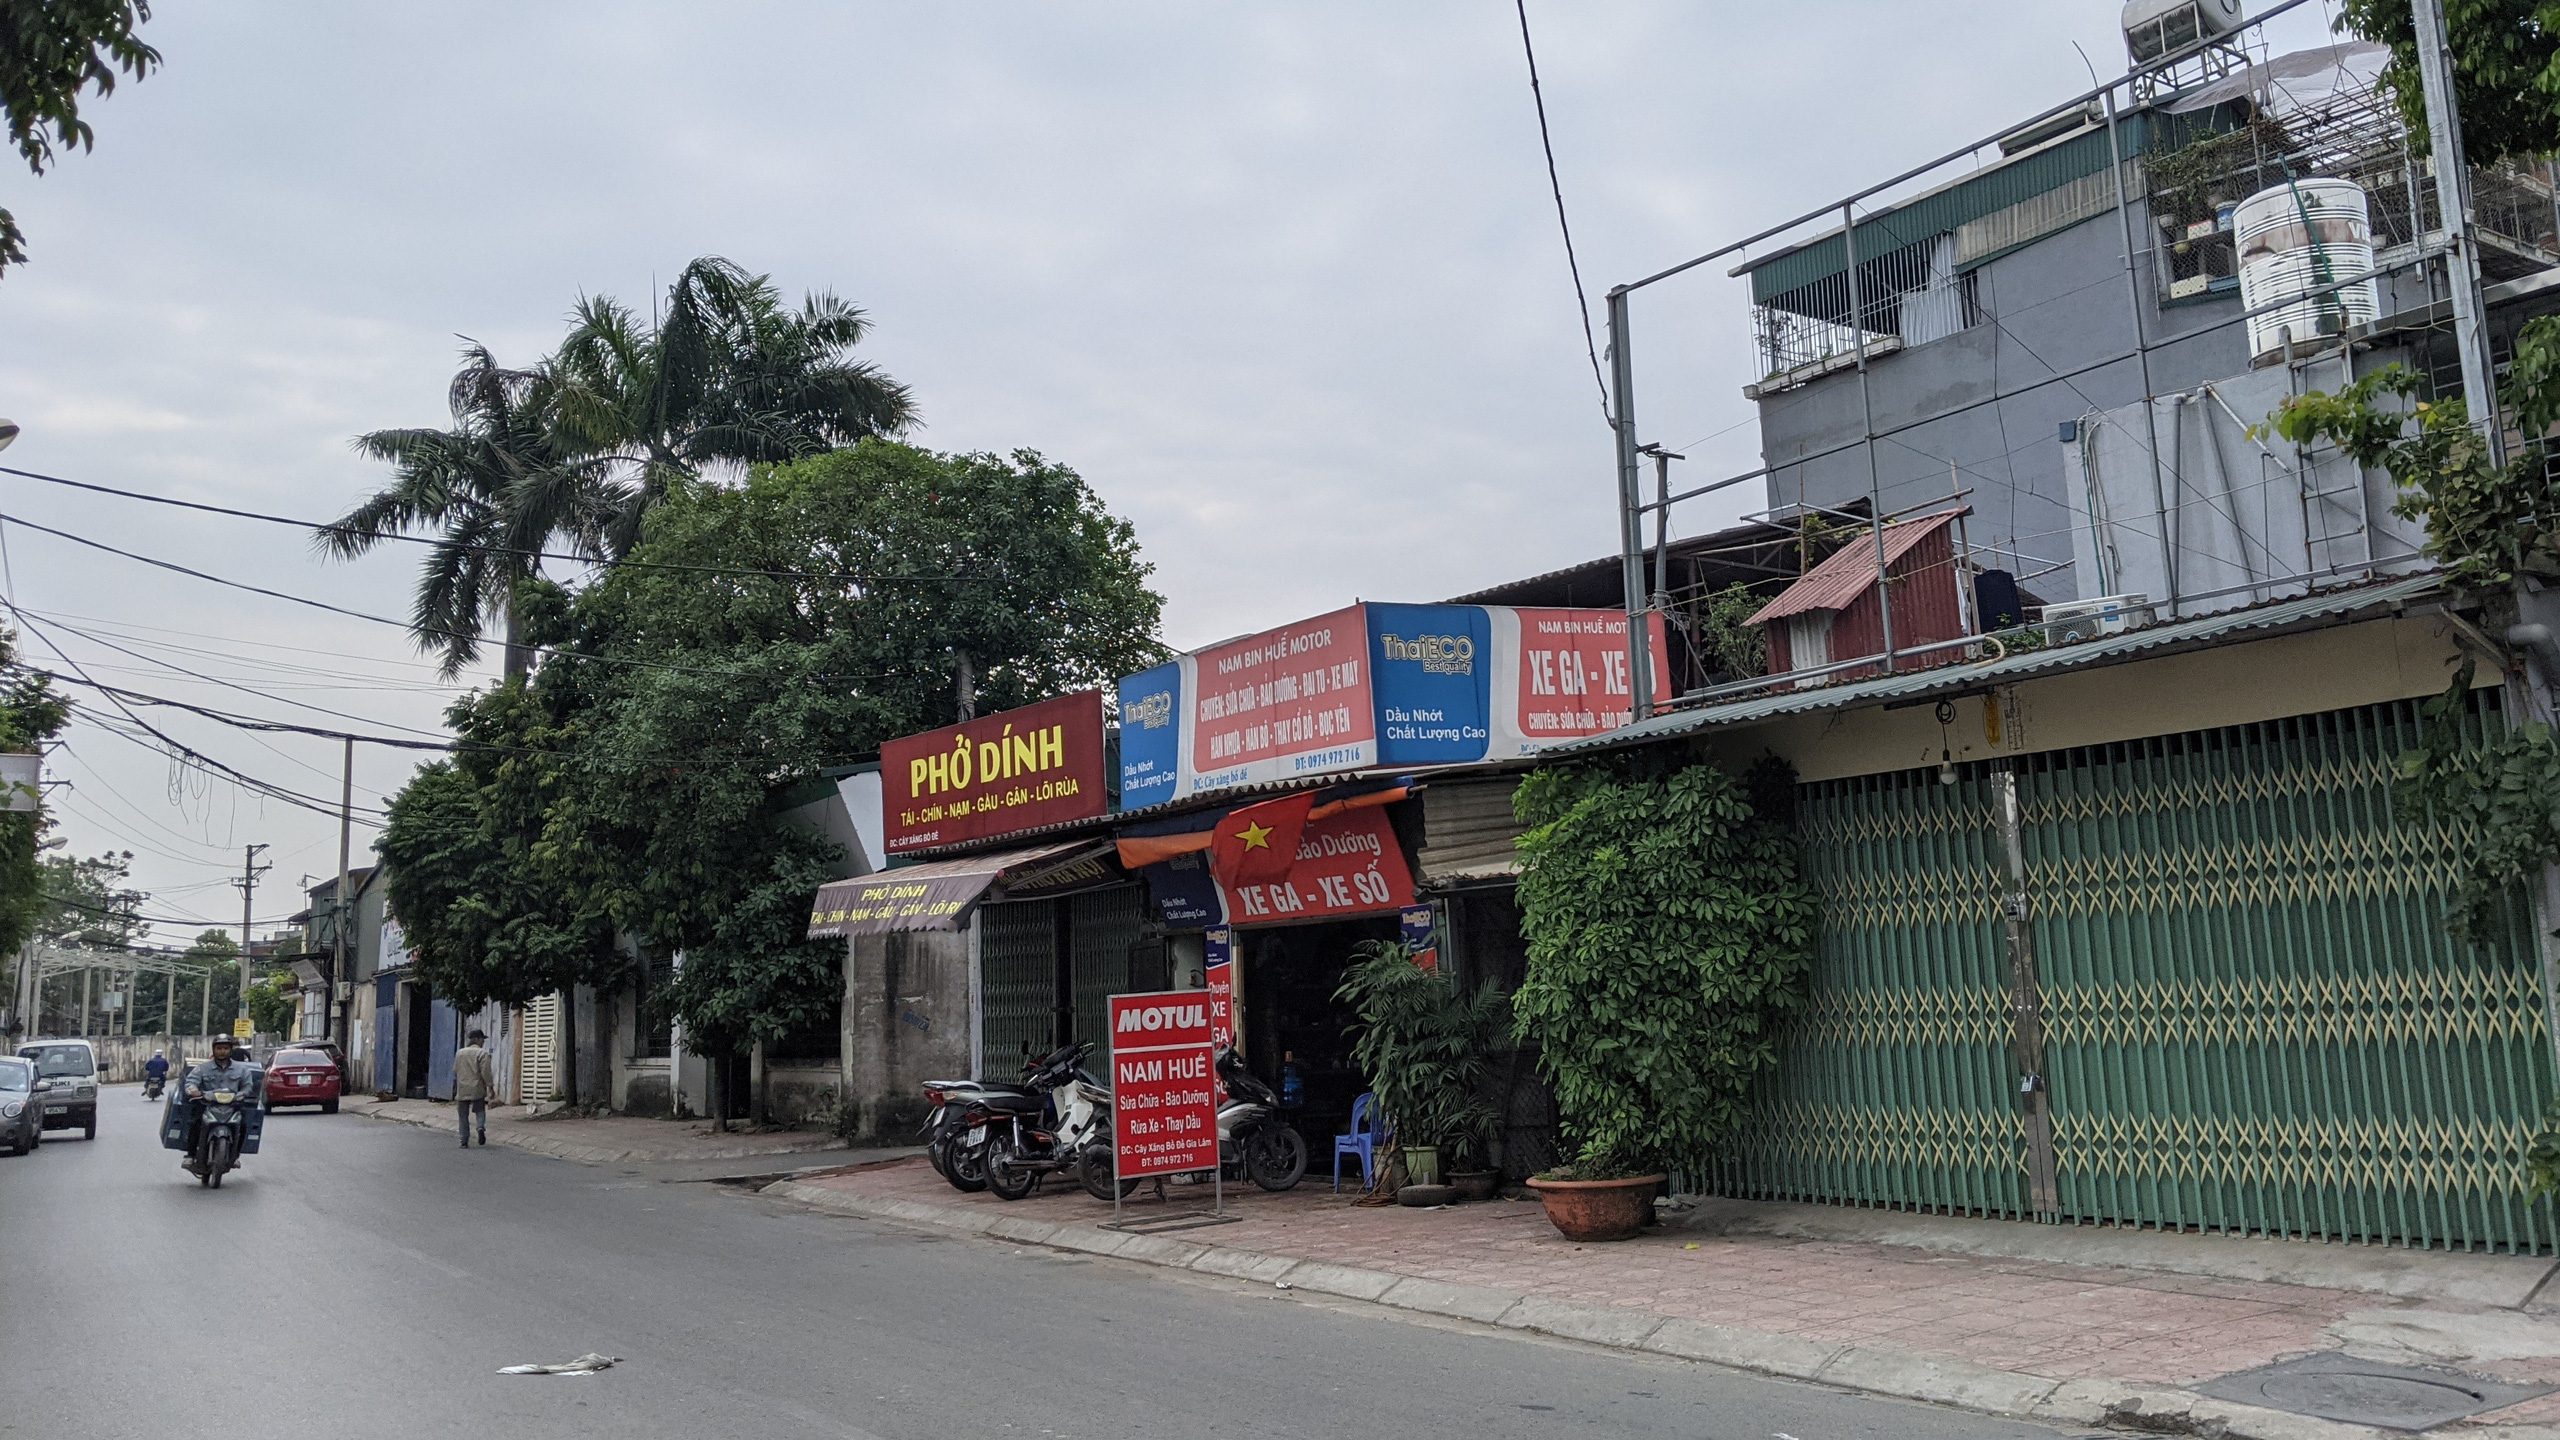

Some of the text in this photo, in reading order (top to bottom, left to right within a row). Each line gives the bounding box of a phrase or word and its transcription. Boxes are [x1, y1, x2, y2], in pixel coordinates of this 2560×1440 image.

[1538, 616, 1627, 634] NAM BIN HUẾ MOT
[1218, 628, 1332, 676] NAM BIN HUẾ MOTOR
[1381, 634, 1474, 660] ThaiECO
[1424, 660, 1472, 676] Best quality
[1528, 650, 1556, 695] XE
[1558, 650, 1588, 696] GA
[1601, 650, 1628, 695] XE
[1260, 672, 1273, 708] BẢO
[1302, 672, 1316, 702] ĐẠI
[1330, 664, 1342, 692] XE
[1342, 656, 1359, 688] MÁY
[1274, 718, 1291, 746] THAY
[1302, 710, 1313, 740] BÔ
[1318, 711, 1334, 742] BỌC
[1334, 703, 1351, 734] YÊN
[1385, 706, 1444, 722] Dầu Nhớt
[1560, 706, 1576, 730] SỬA
[1576, 708, 1596, 730] CHỮA
[1601, 706, 1616, 728] BẢO
[1386, 724, 1486, 742] Chất Lượng Cao
[910, 723, 1063, 798] PHỞ DÍNH
[1124, 760, 1154, 777] Dầu Nhớt
[1295, 747, 1360, 771] ĐT: 0974 972 716
[1124, 770, 1176, 791] Chất Lượng Cao
[900, 808, 915, 827] TÁI
[921, 802, 942, 824] CHÍN
[949, 800, 970, 820] NẠM
[1006, 786, 1028, 807] GÂN
[1036, 780, 1054, 801] LÕI
[1056, 776, 1079, 798] RÙA
[1321, 830, 1382, 856] Dưỡng
[861, 882, 928, 902] PHỞ DÍNH
[1237, 886, 1270, 916] XE
[1270, 881, 1304, 914] GA
[1316, 875, 1354, 908] XE
[1353, 858, 1390, 904] SỐ
[810, 908, 824, 924] TÁI
[826, 906, 846, 924] CHÍN
[850, 908, 871, 924] NẠM
[928, 900, 948, 916] LÕI
[1117, 1004, 1208, 1033] MOTUL
[1212, 1001, 1227, 1017] XE
[1212, 1026, 1230, 1043] GA
[1120, 1052, 1207, 1084] NAM HUẾ
[50, 1080, 71, 1088] ZUKI
[1120, 1094, 1136, 1110] Sửa
[1138, 1093, 1159, 1109] Chữa
[1166, 1090, 1180, 1106] Bảo
[1182, 1090, 1209, 1106] Dưỡng
[1130, 1119, 1147, 1134] Rửa
[1148, 1118, 1159, 1134] Xe
[1165, 1116, 1184, 1134] Thay
[1186, 1111, 1201, 1130] Dầu
[1121, 1146, 1134, 1155] ĐC:
[1186, 1139, 1197, 1148] Gia
[1142, 1154, 1194, 1168] ĐT: 0974 972 716
